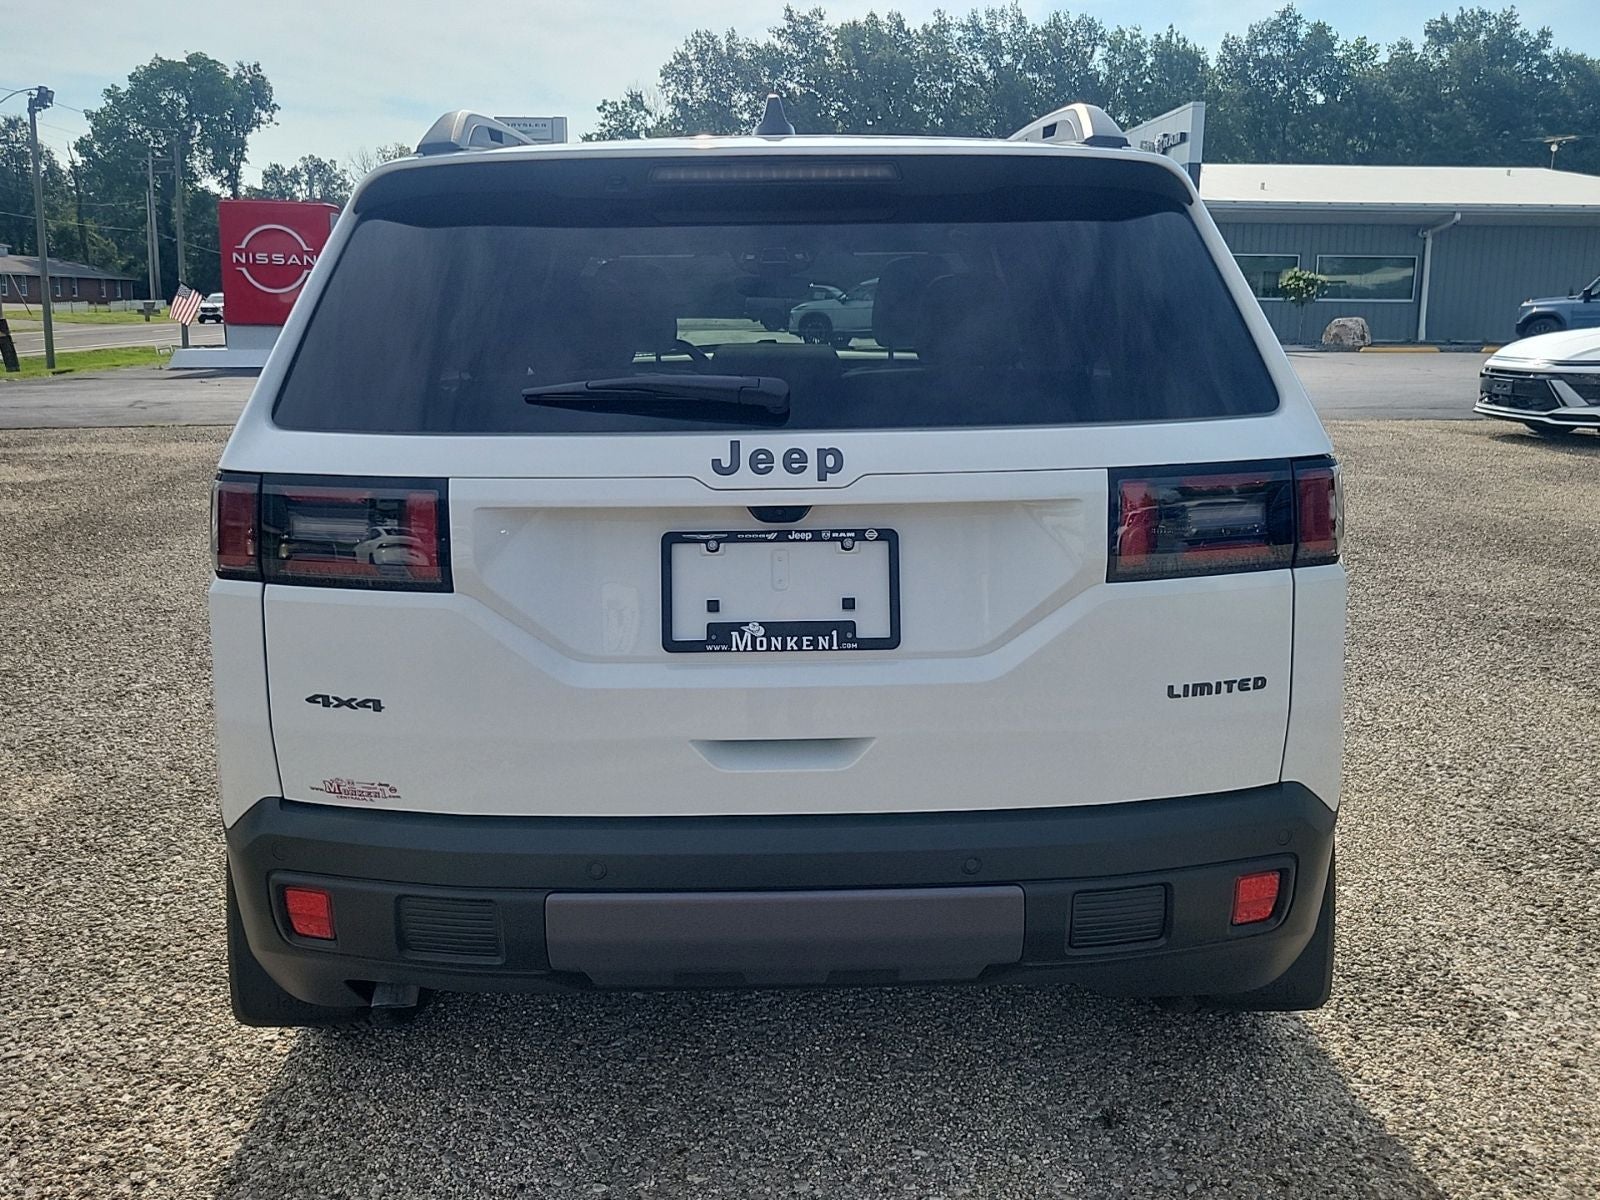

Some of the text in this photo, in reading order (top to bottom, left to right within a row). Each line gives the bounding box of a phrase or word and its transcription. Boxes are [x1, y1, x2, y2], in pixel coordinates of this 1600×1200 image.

[232, 252, 317, 266] NISSAN
[711, 440, 844, 482] Jeep
[788, 531, 812, 540] Jeep
[1167, 676, 1267, 698] LIMITED
